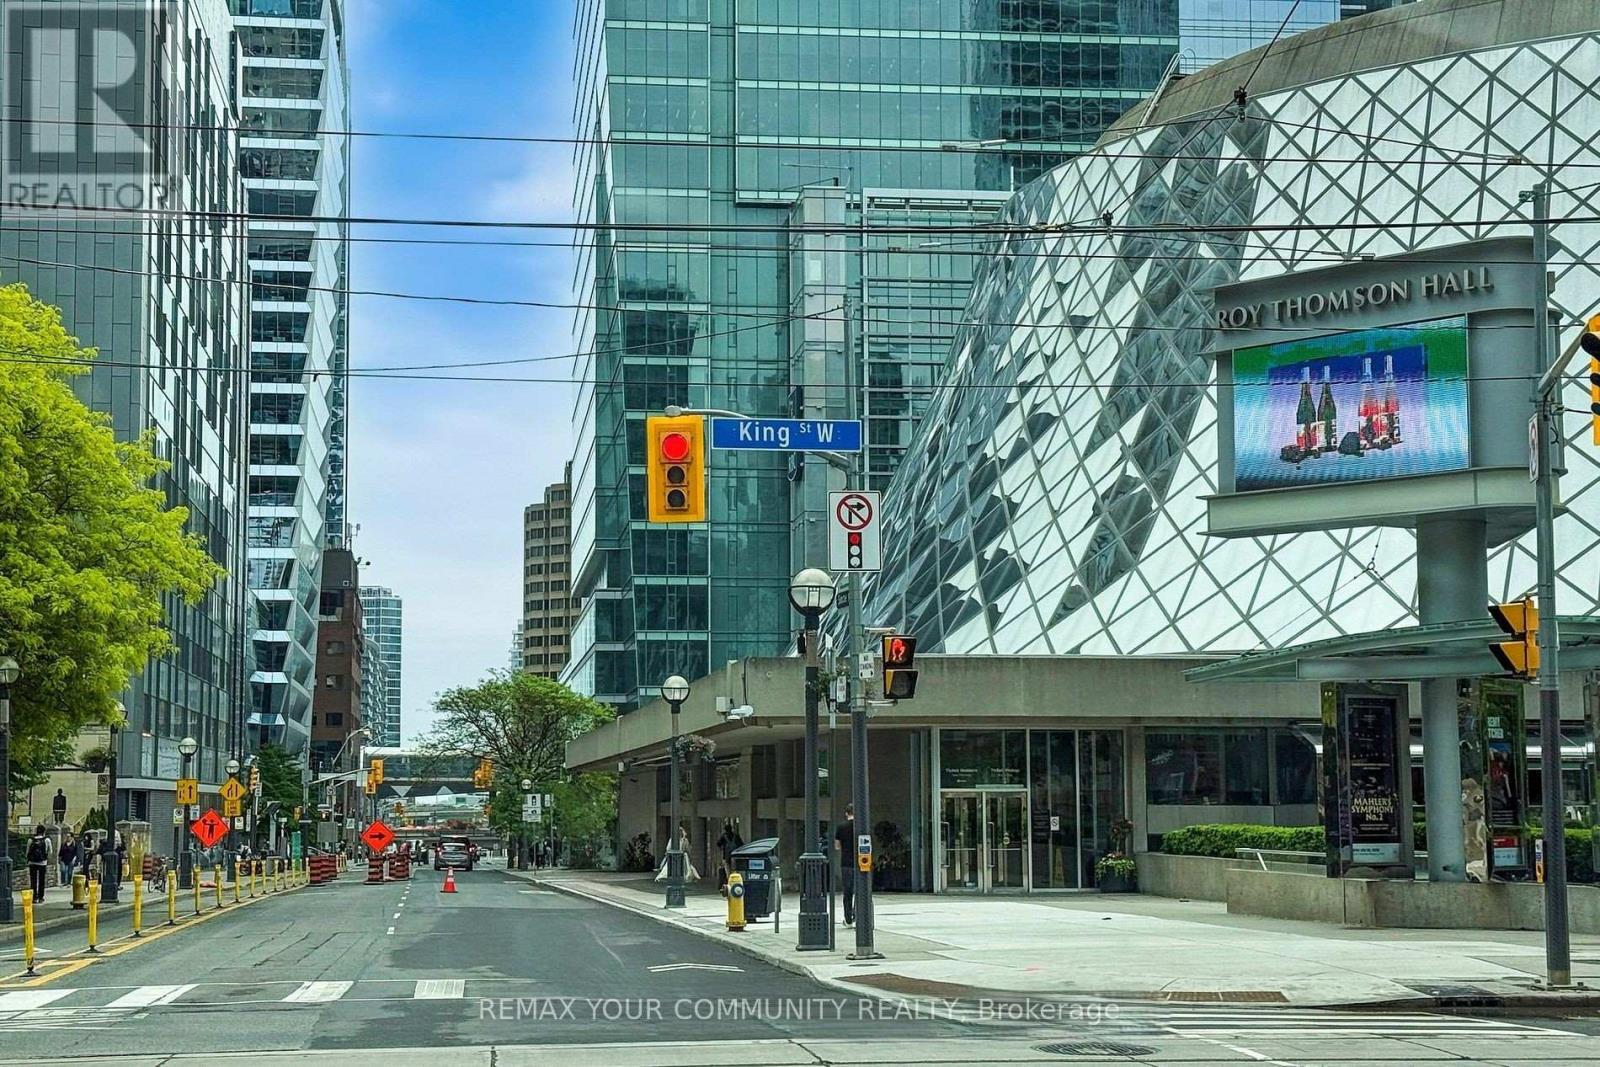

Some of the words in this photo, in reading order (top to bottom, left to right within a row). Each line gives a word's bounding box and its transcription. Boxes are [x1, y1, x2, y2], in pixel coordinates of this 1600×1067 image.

[1216, 303, 1264, 329] ROY
[1271, 279, 1409, 322] THOMSON
[1421, 266, 1494, 298] HALL
[739, 421, 790, 448] King
[799, 422, 811, 434] St
[816, 422, 834, 443] W
[1351, 805, 1393, 813] SYMPHONY
